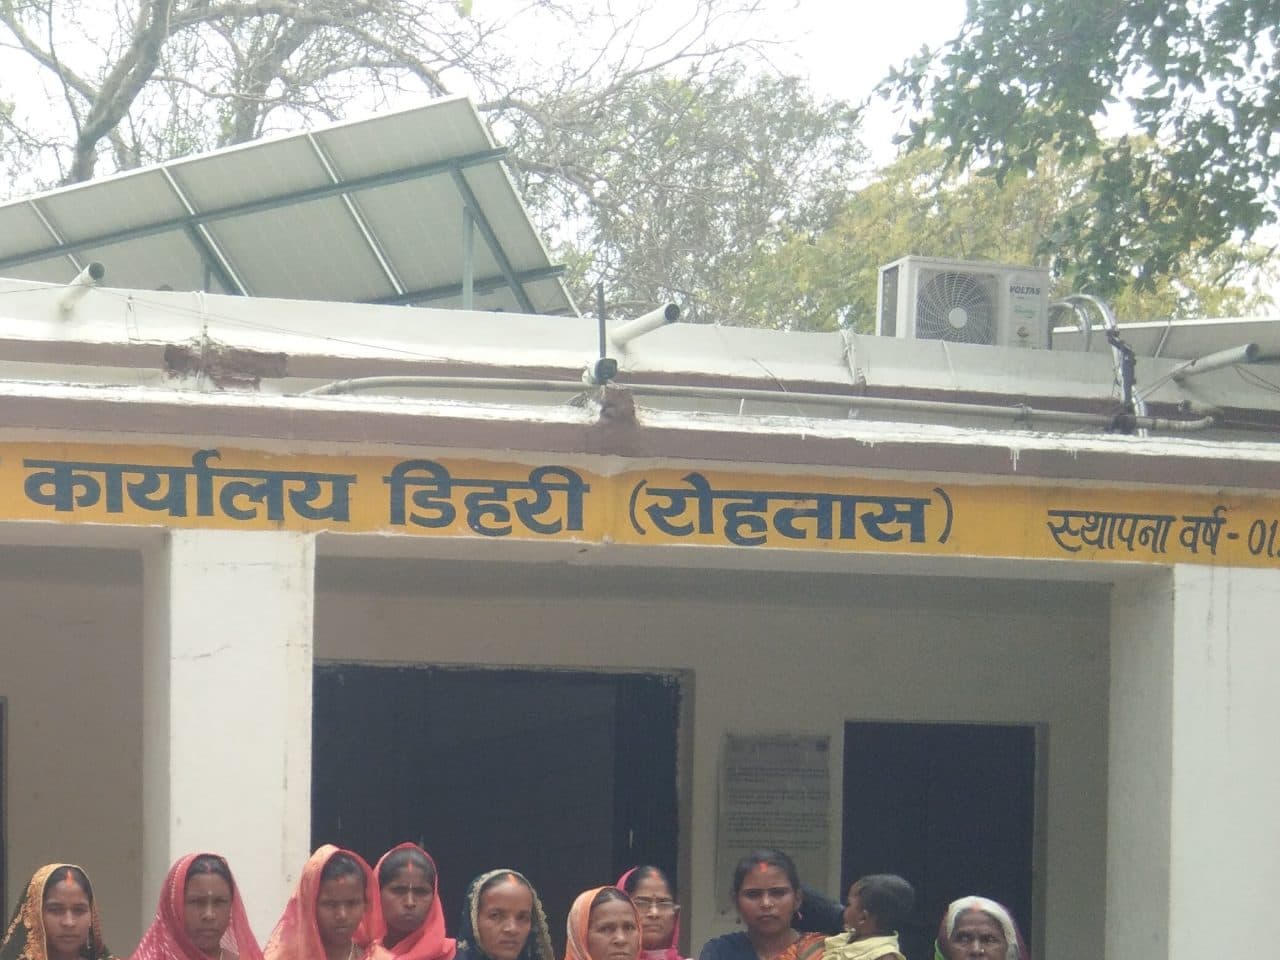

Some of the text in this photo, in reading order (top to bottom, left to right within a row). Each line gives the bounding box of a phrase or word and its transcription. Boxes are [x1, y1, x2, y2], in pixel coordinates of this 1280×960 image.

[1009, 285, 1041, 296] VOLTAS
[23, 448, 358, 522] कार्यालय
[382, 458, 591, 537] डिहरी
[628, 472, 954, 547] (रोहतास)
[1047, 509, 1177, 553] स्थापना
